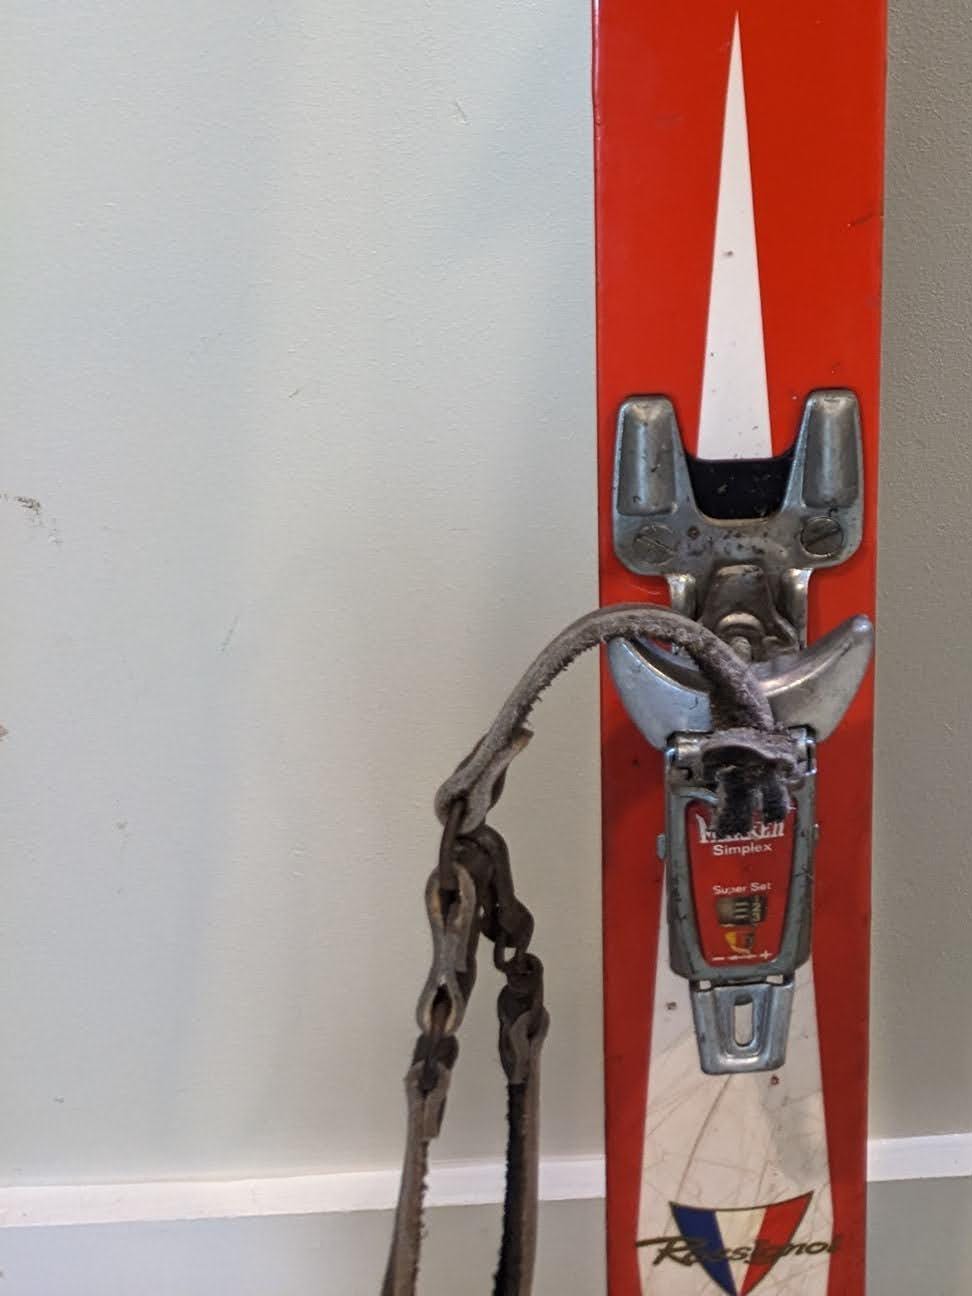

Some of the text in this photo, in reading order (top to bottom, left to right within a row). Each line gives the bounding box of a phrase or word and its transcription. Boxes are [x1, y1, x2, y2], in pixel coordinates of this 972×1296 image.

[712, 842, 773, 856] Simplex
[712, 882, 772, 895] Super Set
